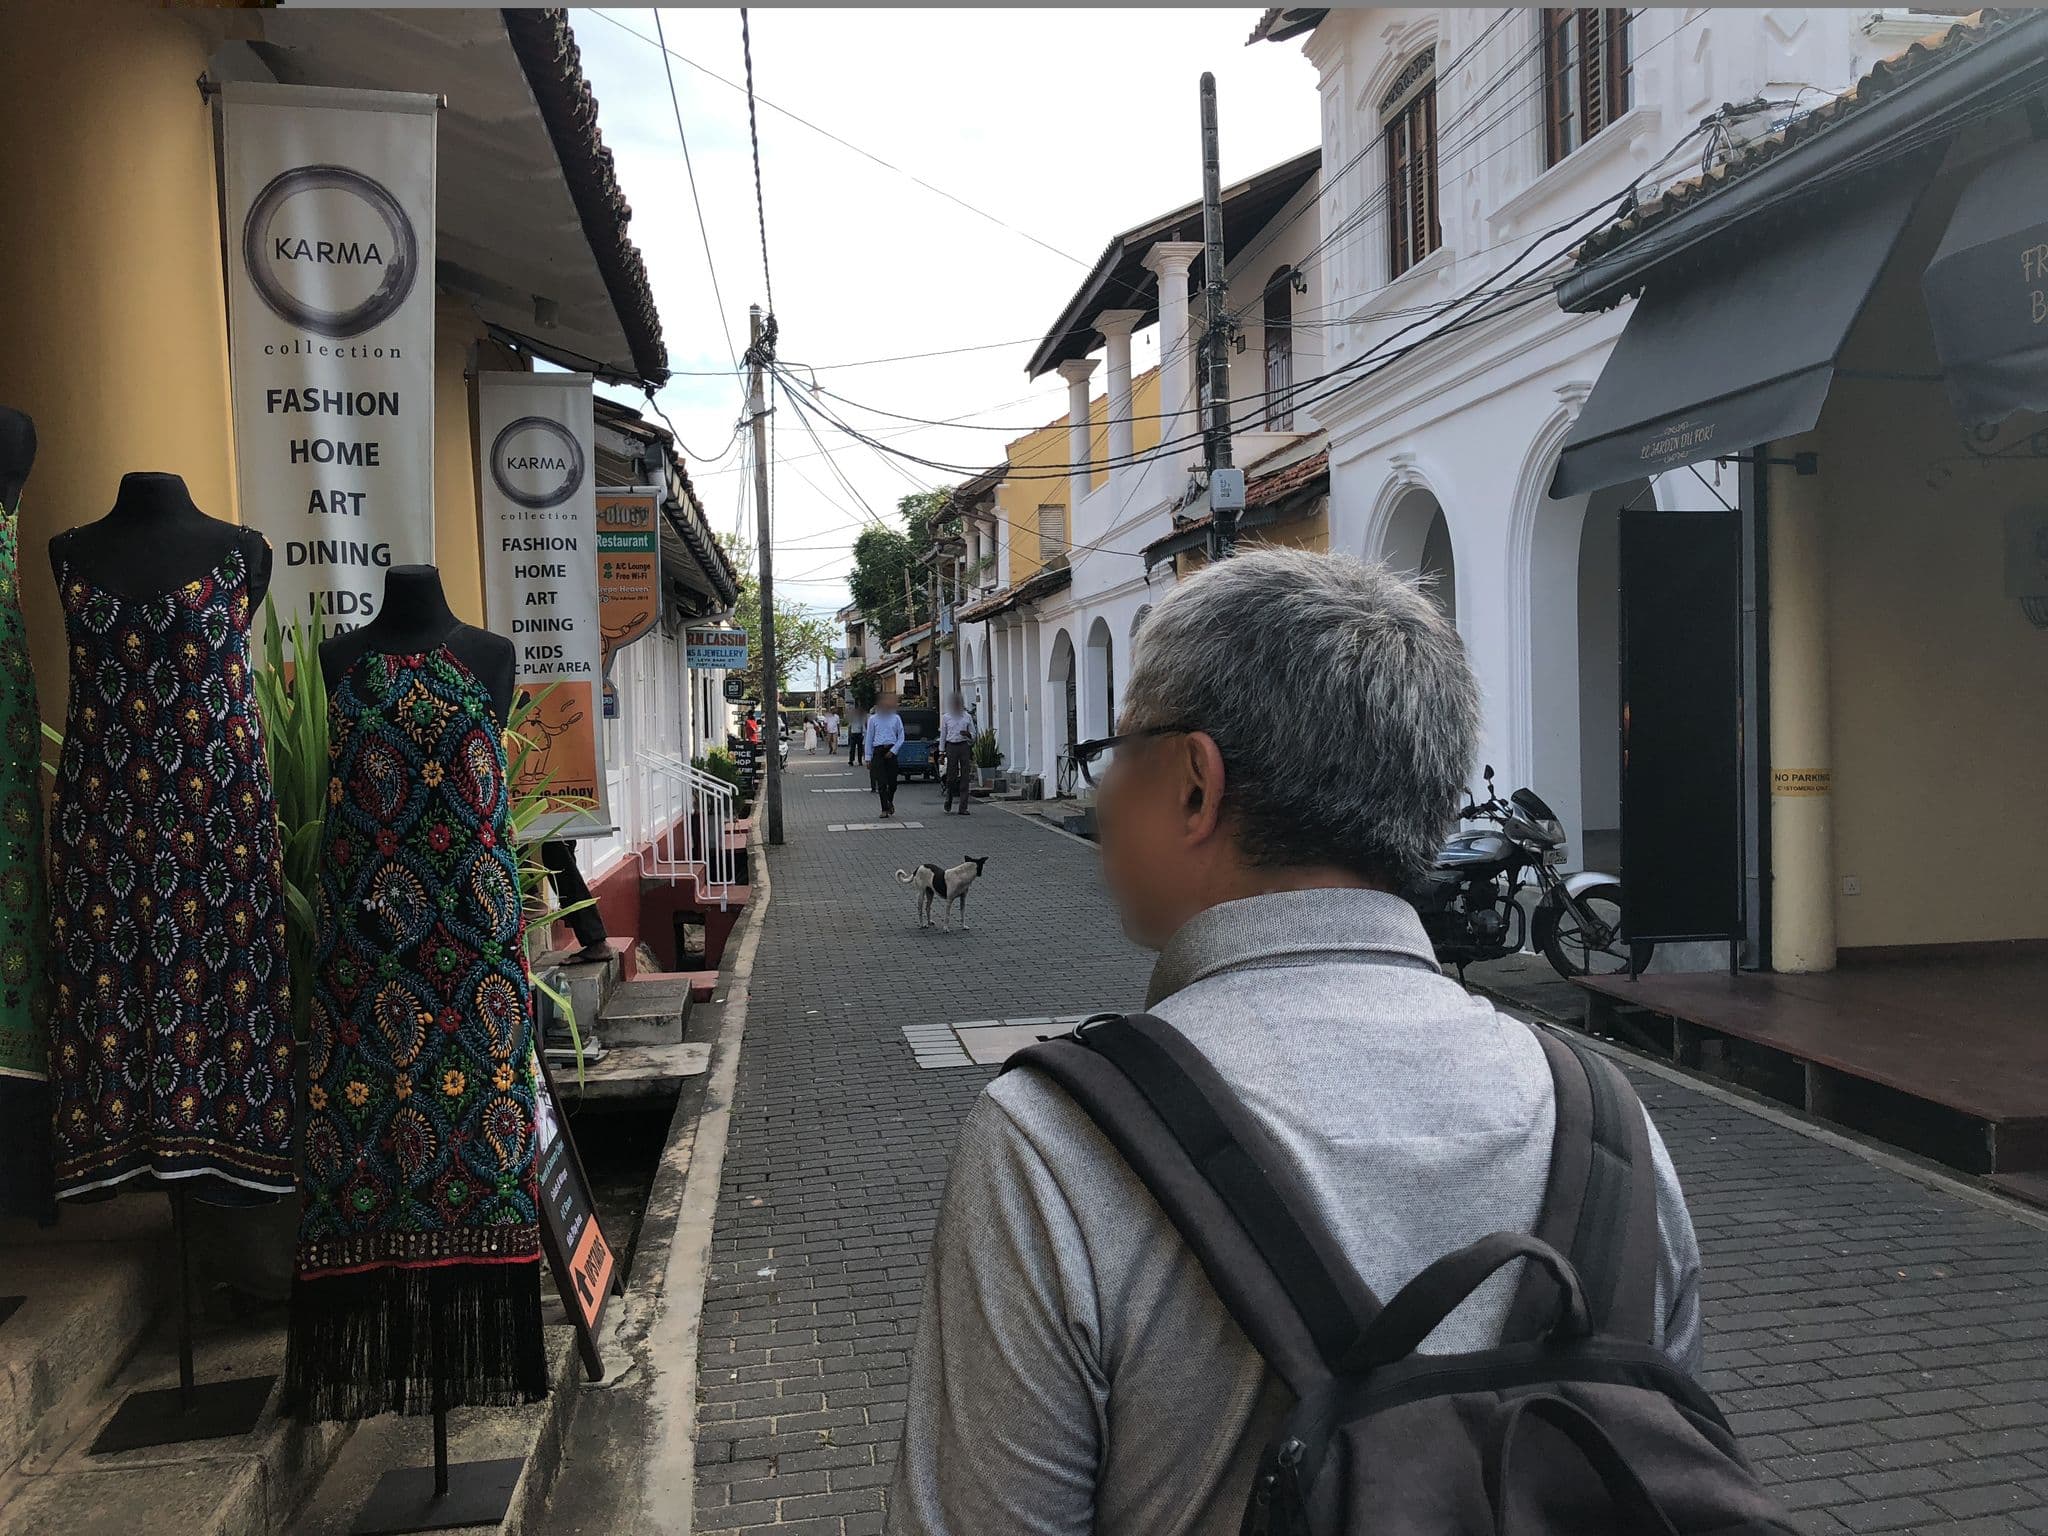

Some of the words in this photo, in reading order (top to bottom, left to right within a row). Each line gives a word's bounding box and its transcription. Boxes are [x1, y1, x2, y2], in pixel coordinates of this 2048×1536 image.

[276, 237, 383, 265] KARMA
[264, 338, 401, 359] collection
[267, 387, 399, 417] FASHION
[290, 438, 380, 467] HOME
[507, 456, 566, 470] KARMA
[307, 489, 366, 517] ART
[500, 511, 577, 521] collection
[502, 537, 577, 552] FASHION
[596, 534, 649, 547] Restaurant
[286, 540, 392, 568] DINING
[514, 564, 566, 579] HOME
[628, 562, 651, 572] Lounge
[615, 572, 631, 580] Free
[309, 590, 375, 616] KIDS
[525, 591, 558, 606] ART
[511, 618, 574, 634] DINING
[524, 645, 563, 660] KIDS
[703, 649, 743, 658] JEWELLERY
[523, 662, 554, 675] PLAY
[556, 661, 591, 673] AREA
[734, 750, 752, 758] PICE
[735, 758, 752, 766] HOP
[1774, 773, 1789, 782] NO
[1791, 773, 1831, 782] PARKING
